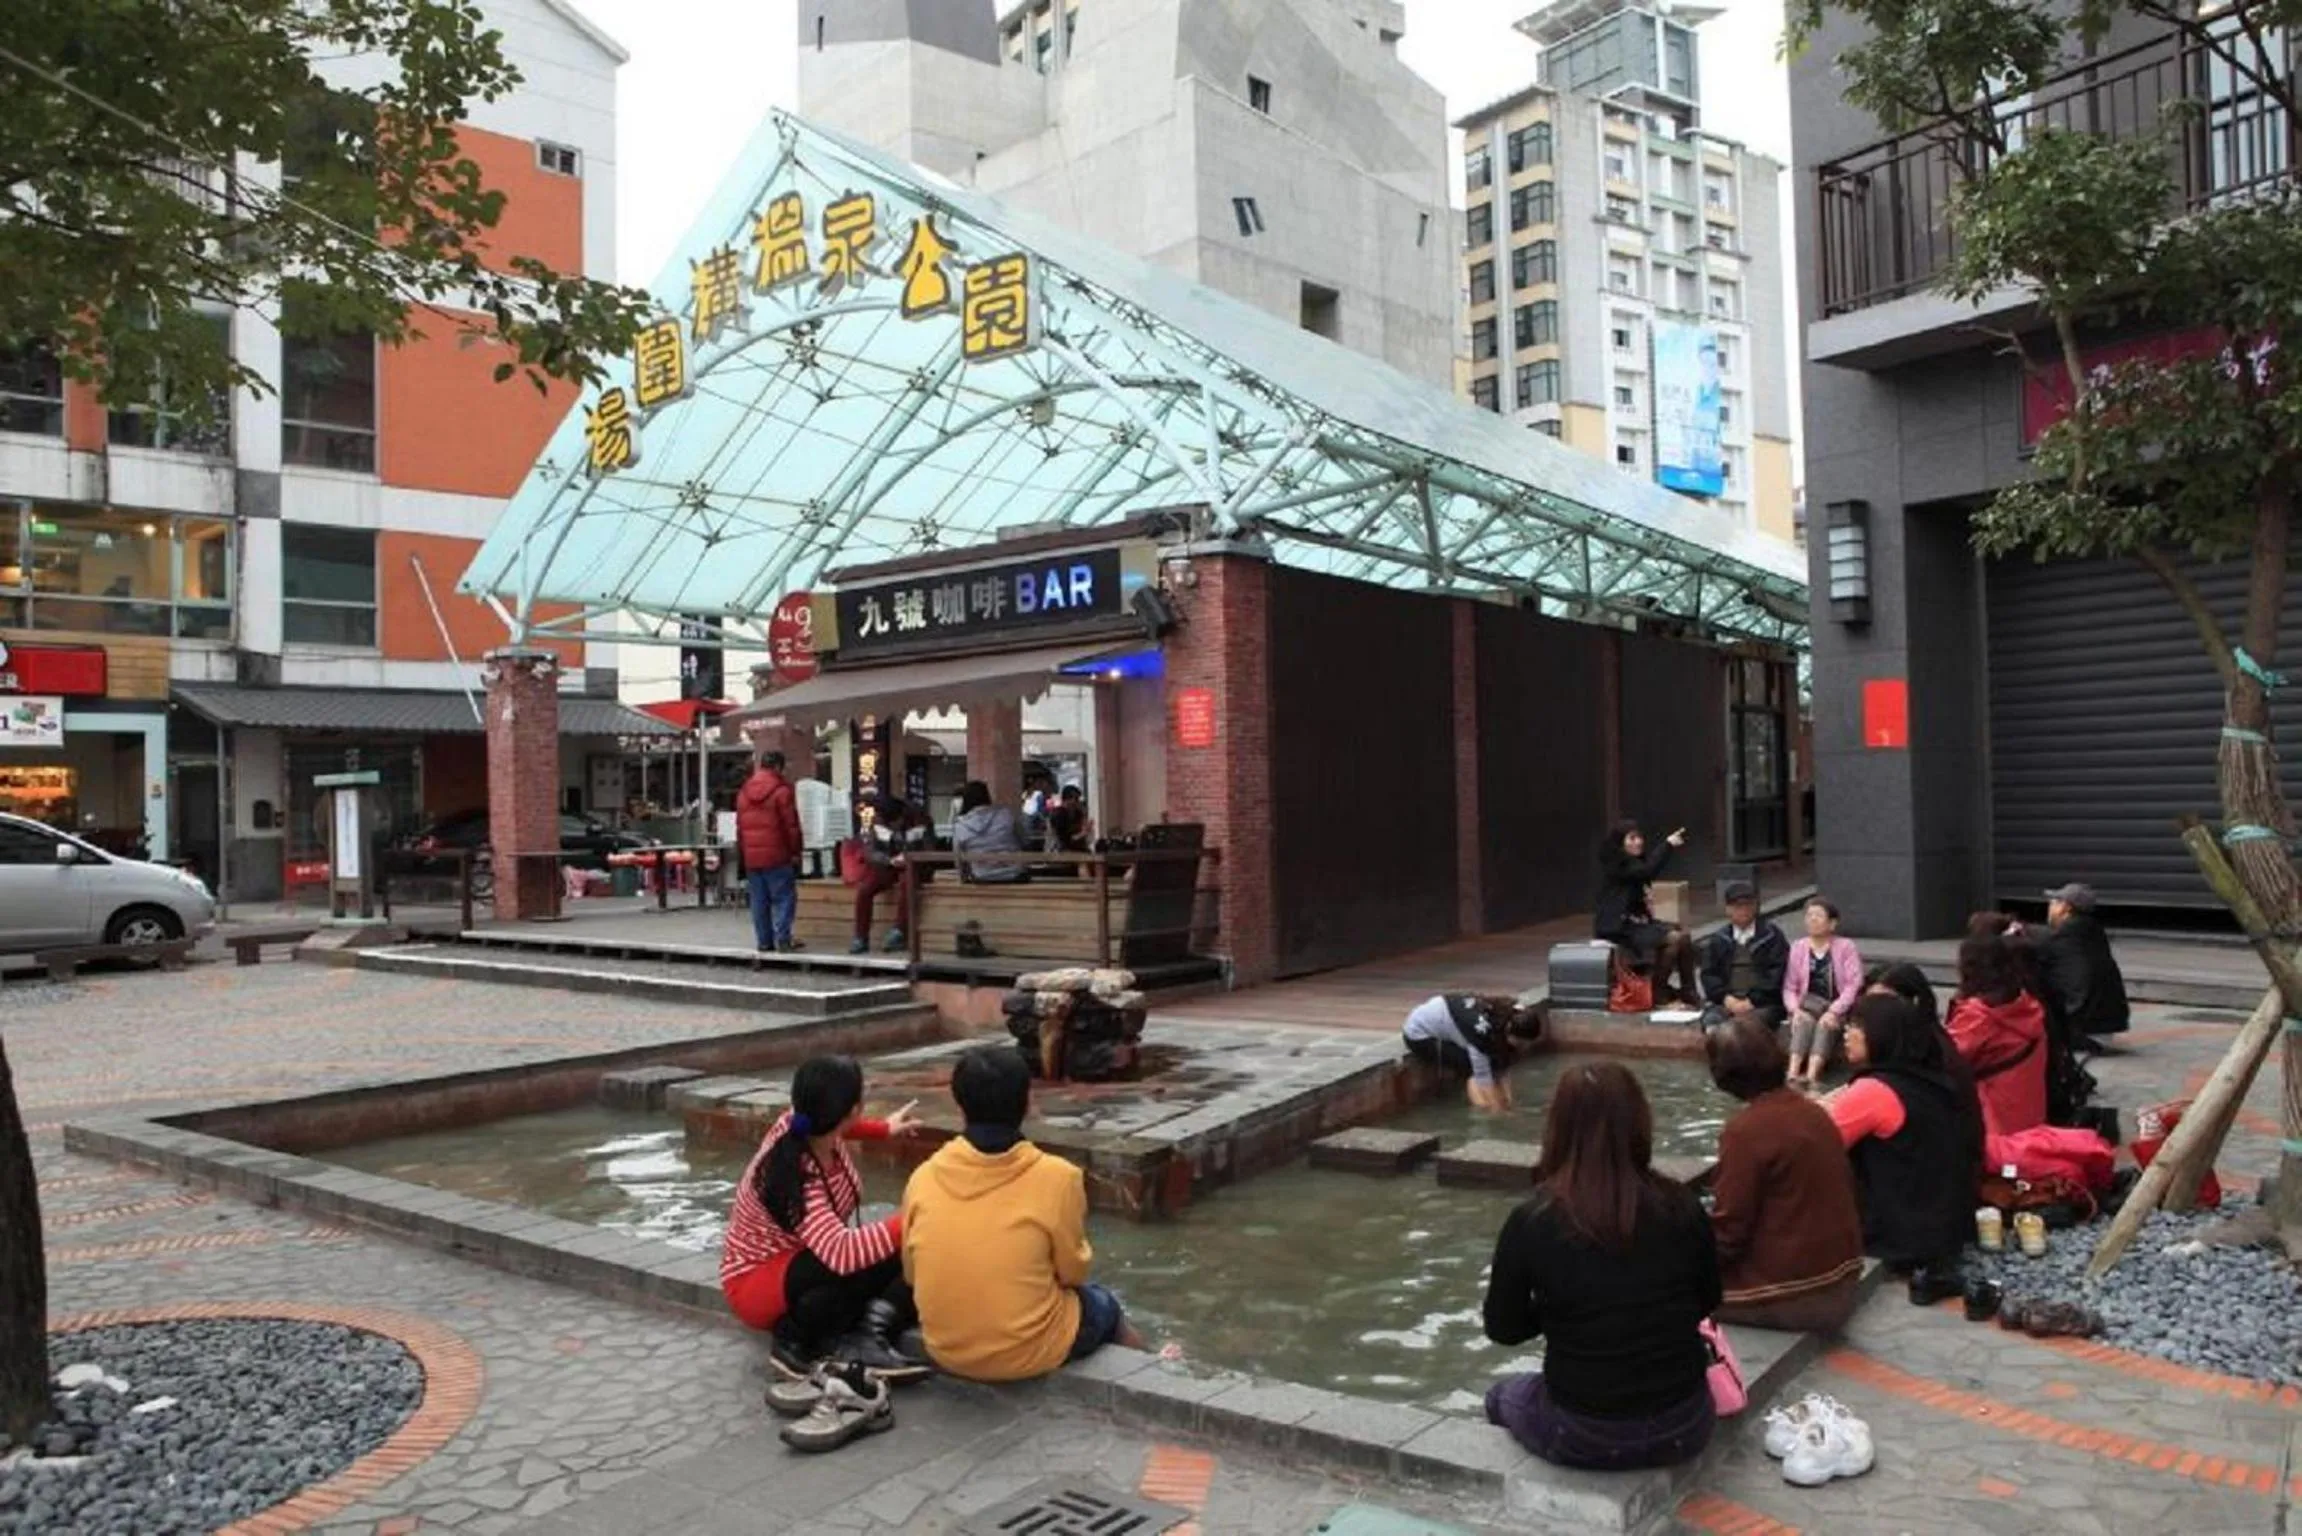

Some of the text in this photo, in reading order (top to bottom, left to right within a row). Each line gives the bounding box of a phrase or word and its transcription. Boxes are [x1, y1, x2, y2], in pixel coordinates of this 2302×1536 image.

[858, 576, 1007, 638] 九號咖啡
[1015, 564, 1094, 614] BAR
